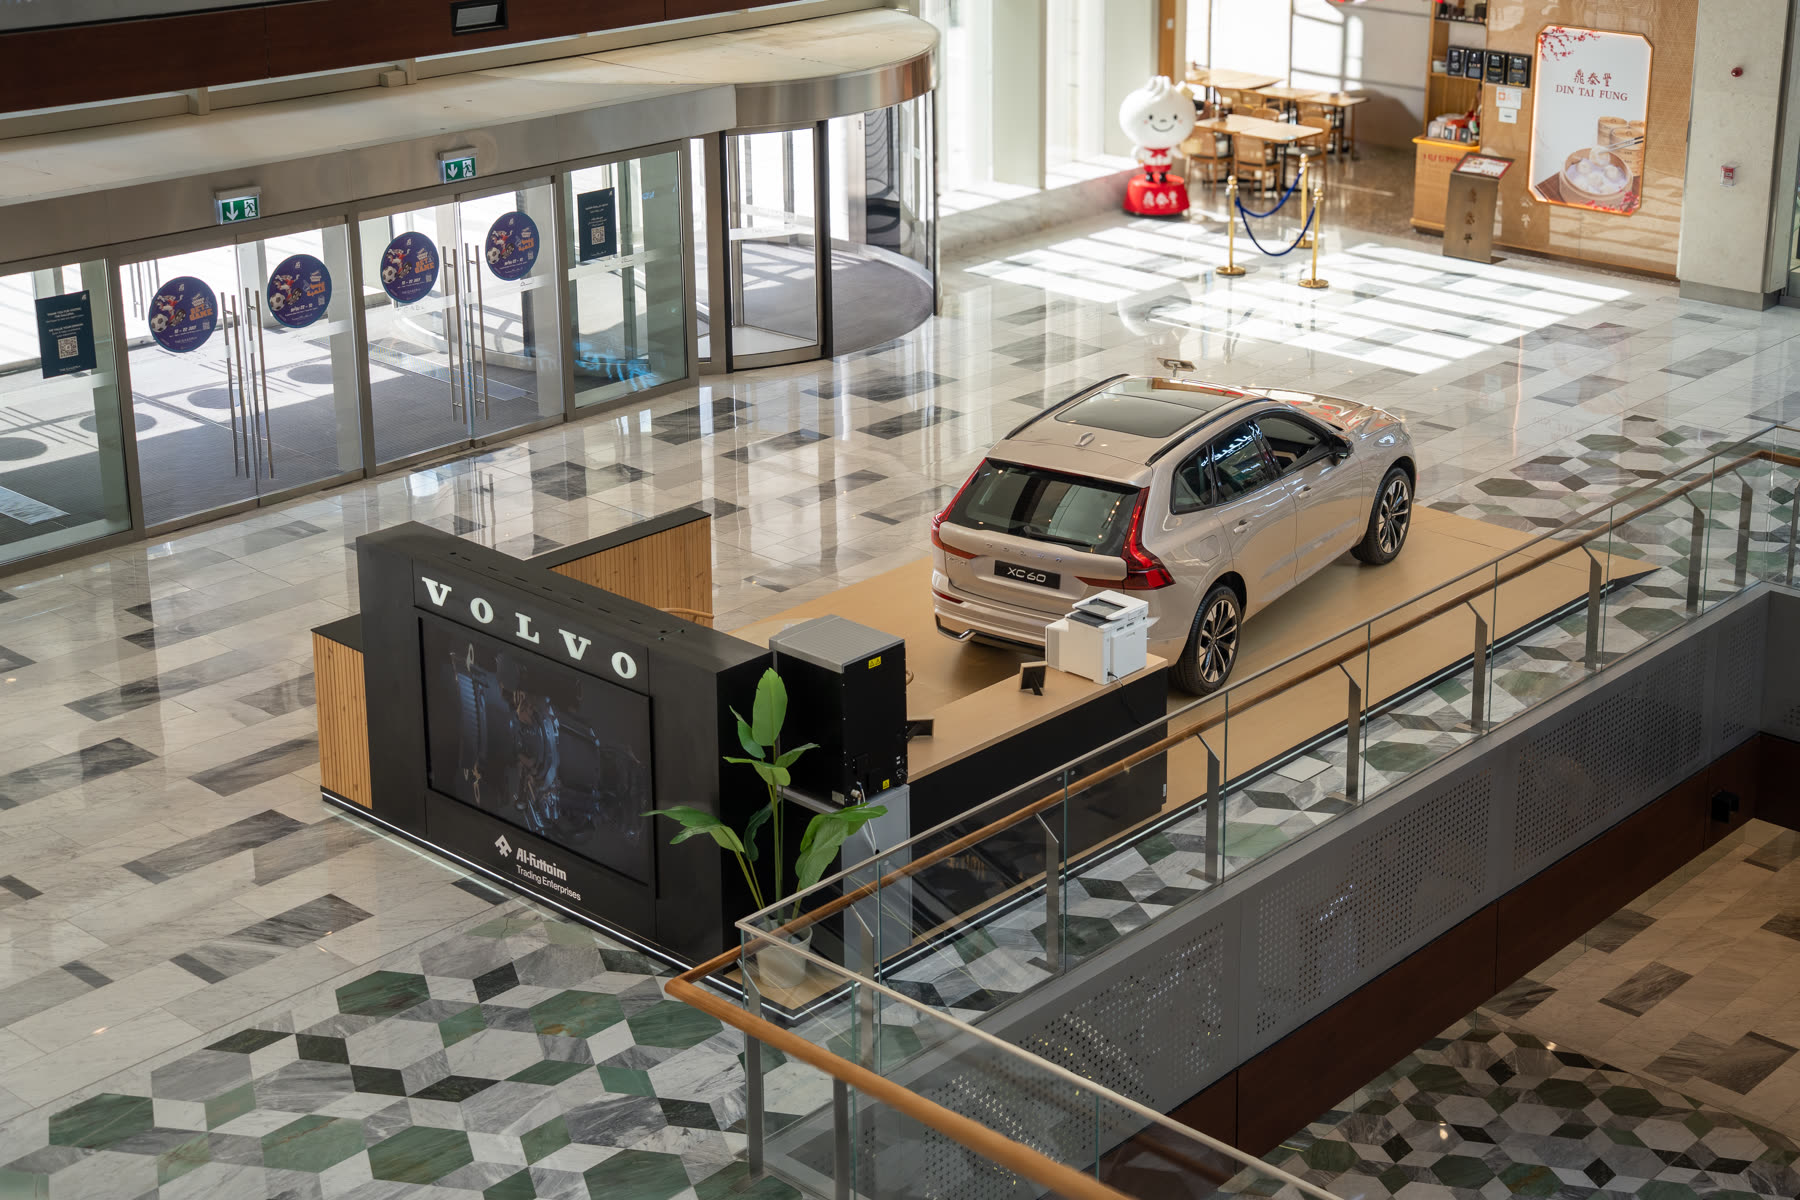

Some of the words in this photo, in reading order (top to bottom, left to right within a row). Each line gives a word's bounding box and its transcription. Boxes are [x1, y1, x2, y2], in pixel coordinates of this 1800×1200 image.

[1555, 84, 1575, 94] DIN
[1579, 87, 1595, 98] TAI
[1599, 89, 1629, 102] FUNG
[421, 576, 638, 680] VOLVO
[516, 847, 567, 881] Al-Futtaim
[516, 864, 542, 885] Trading
[542, 877, 582, 901] Enterprises
